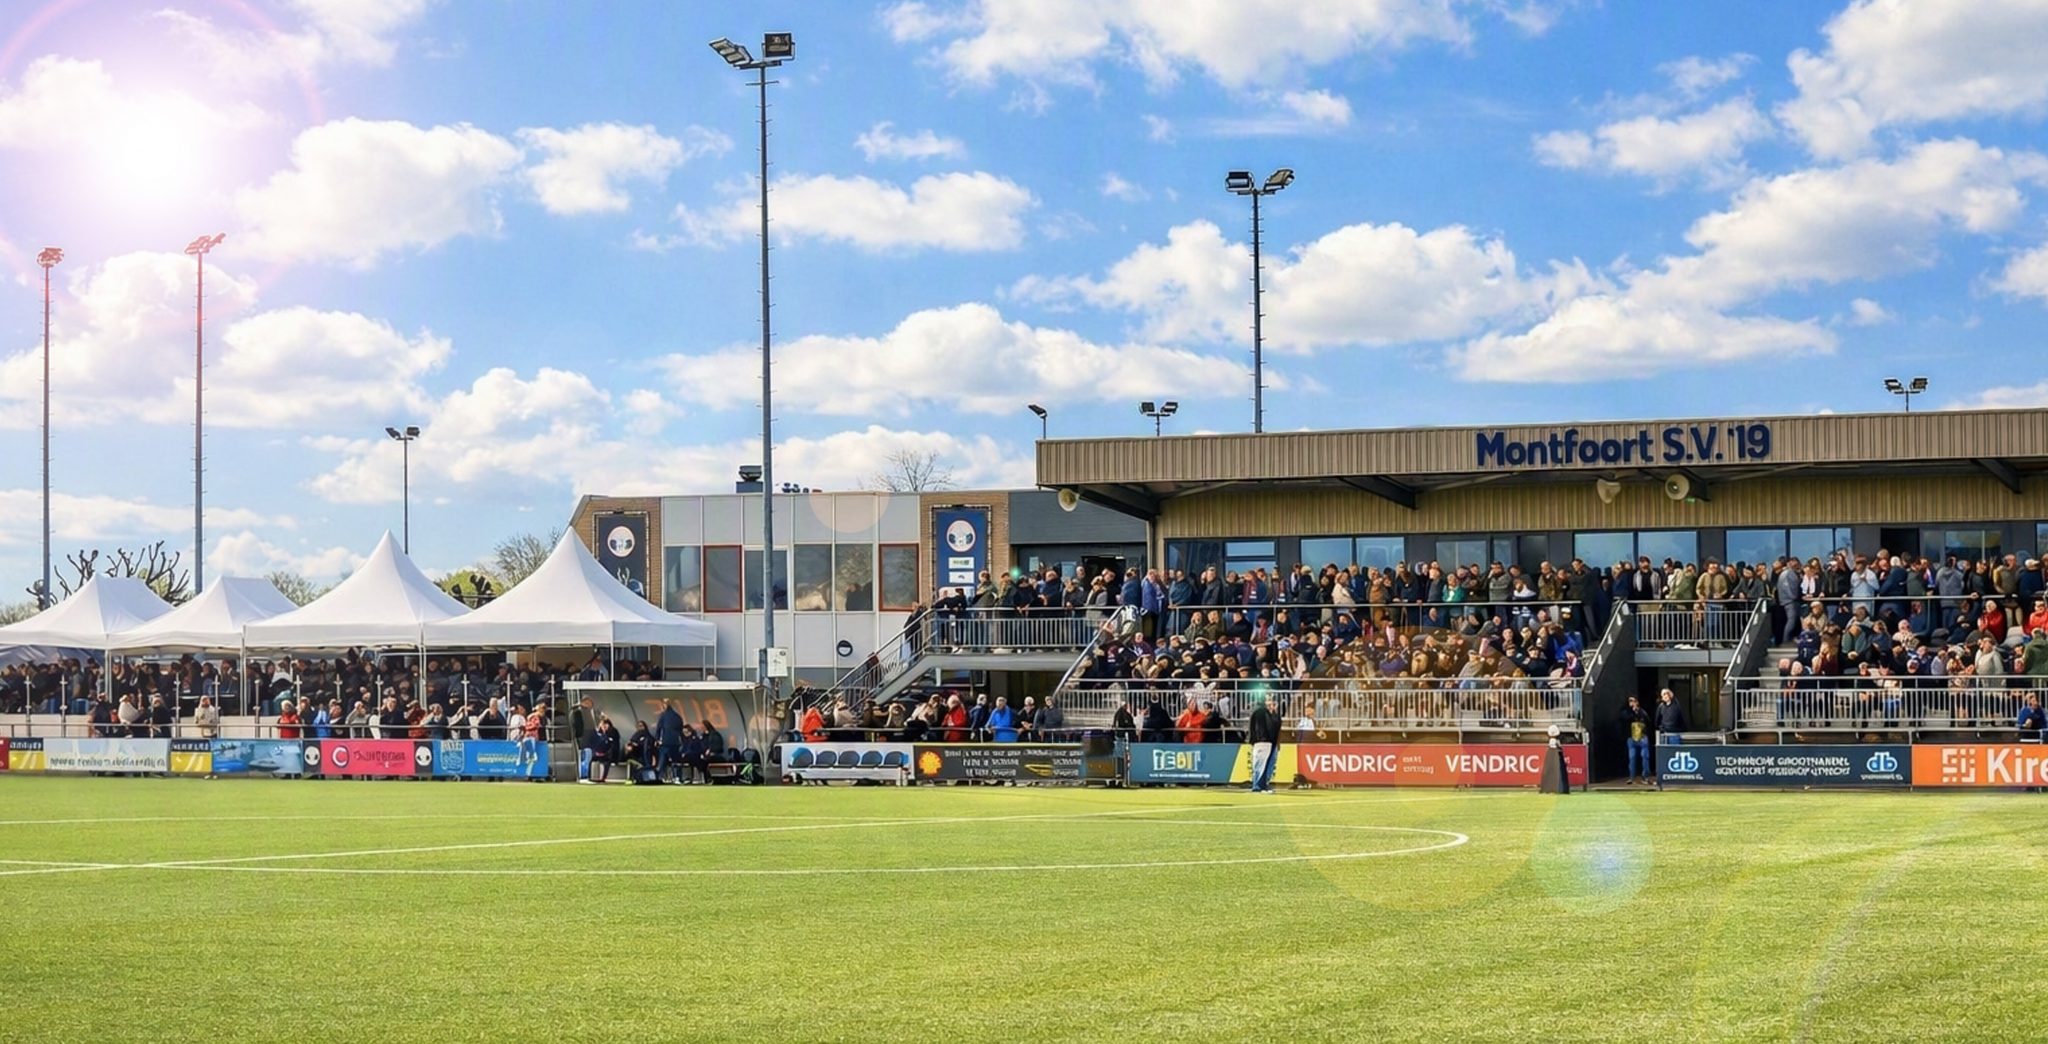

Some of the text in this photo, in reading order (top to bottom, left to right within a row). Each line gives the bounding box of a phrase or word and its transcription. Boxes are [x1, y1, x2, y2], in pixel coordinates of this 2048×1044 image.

[1476, 428, 1654, 466] Montfoort
[1662, 426, 1723, 462] S.V.
[1305, 753, 1397, 773] VENDRIG
